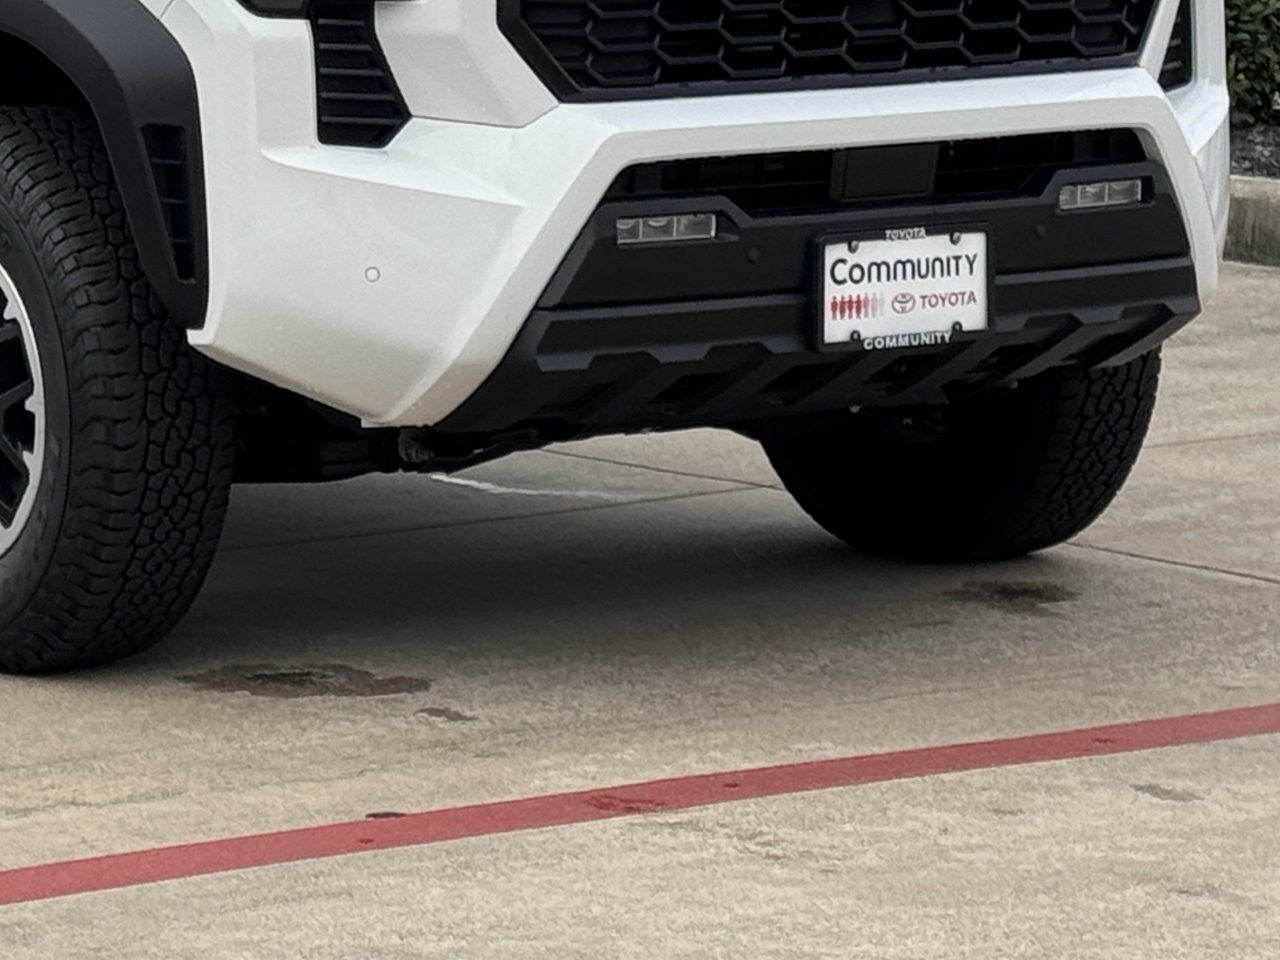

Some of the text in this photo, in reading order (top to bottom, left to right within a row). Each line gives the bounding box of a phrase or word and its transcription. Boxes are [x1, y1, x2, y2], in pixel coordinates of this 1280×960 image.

[885, 227, 927, 241] TOYOTA
[919, 290, 977, 309] TOYOTA
[863, 330, 953, 350] COMMUNITY
